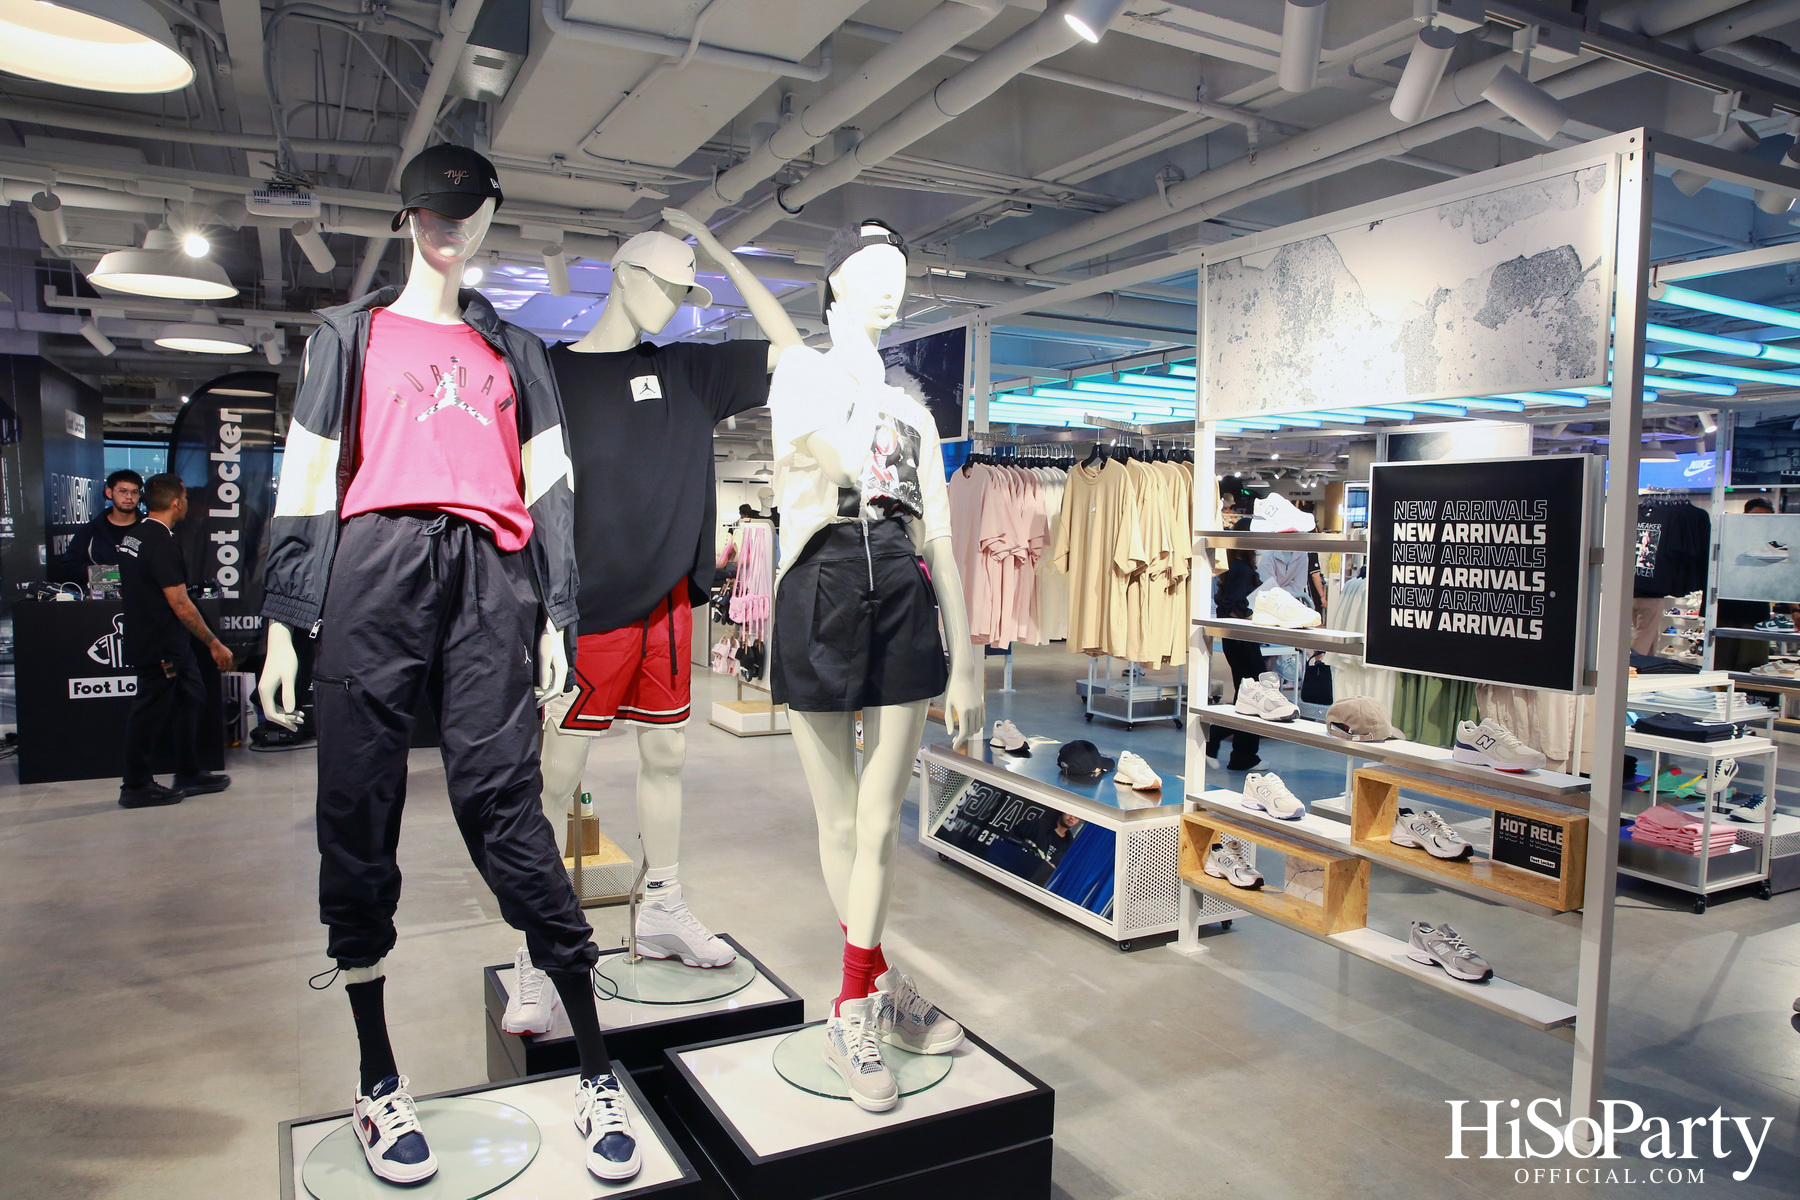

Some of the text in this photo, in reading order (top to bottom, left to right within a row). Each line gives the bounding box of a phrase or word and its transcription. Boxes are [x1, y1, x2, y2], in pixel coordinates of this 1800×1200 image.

[444, 169, 469, 185] nyc
[209, 407, 243, 518] Locker
[1688, 459, 1713, 469] NIKE
[1393, 499, 1548, 521] NEW ARRIVALS
[1393, 522, 1547, 545] NEW ARRIVALS
[1392, 543, 1546, 568] NEW ARRIVALS
[1391, 565, 1546, 592] NEW ARRIVALS
[1390, 586, 1545, 616] NEW ARRIVALS
[1390, 607, 1543, 640] NEW ARRIVALS
[74, 681, 112, 695] Foot
[1500, 817, 1527, 836] HOT
[1530, 825, 1563, 846] RELE
